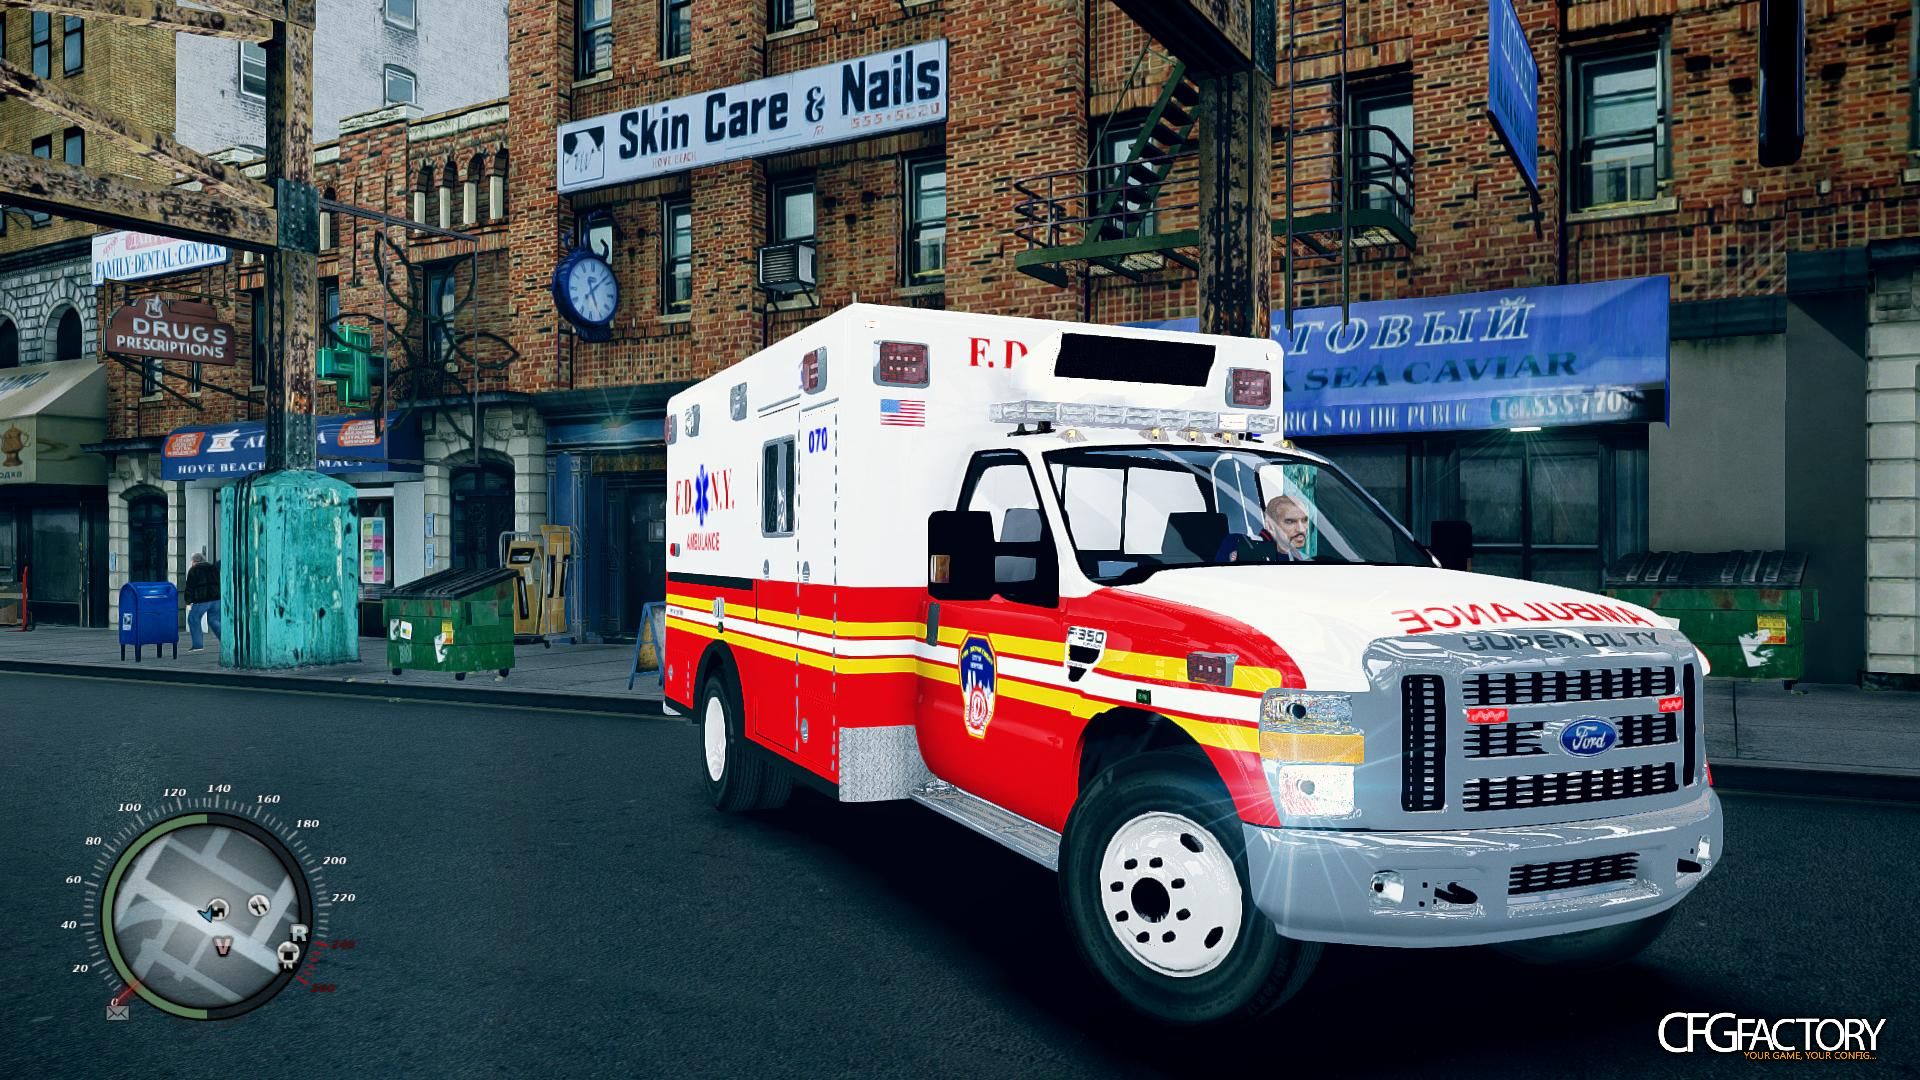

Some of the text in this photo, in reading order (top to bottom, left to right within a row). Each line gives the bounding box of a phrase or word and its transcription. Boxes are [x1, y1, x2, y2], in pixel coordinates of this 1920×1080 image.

[619, 50, 940, 160] Skin Care & Nails
[95, 256, 134, 281] FAMILY
[135, 247, 175, 273] DENTAL
[133, 317, 227, 345] DRUGS
[116, 335, 224, 359] PRESCRIPTIONS
[1304, 366, 1390, 392] SEA
[1403, 351, 1580, 385] CAVIAR
[808, 427, 828, 454] 070
[686, 532, 720, 552] AMBULANCE
[1462, 631, 1660, 651] SUPER DUTY
[1572, 725, 1607, 751] Ford
